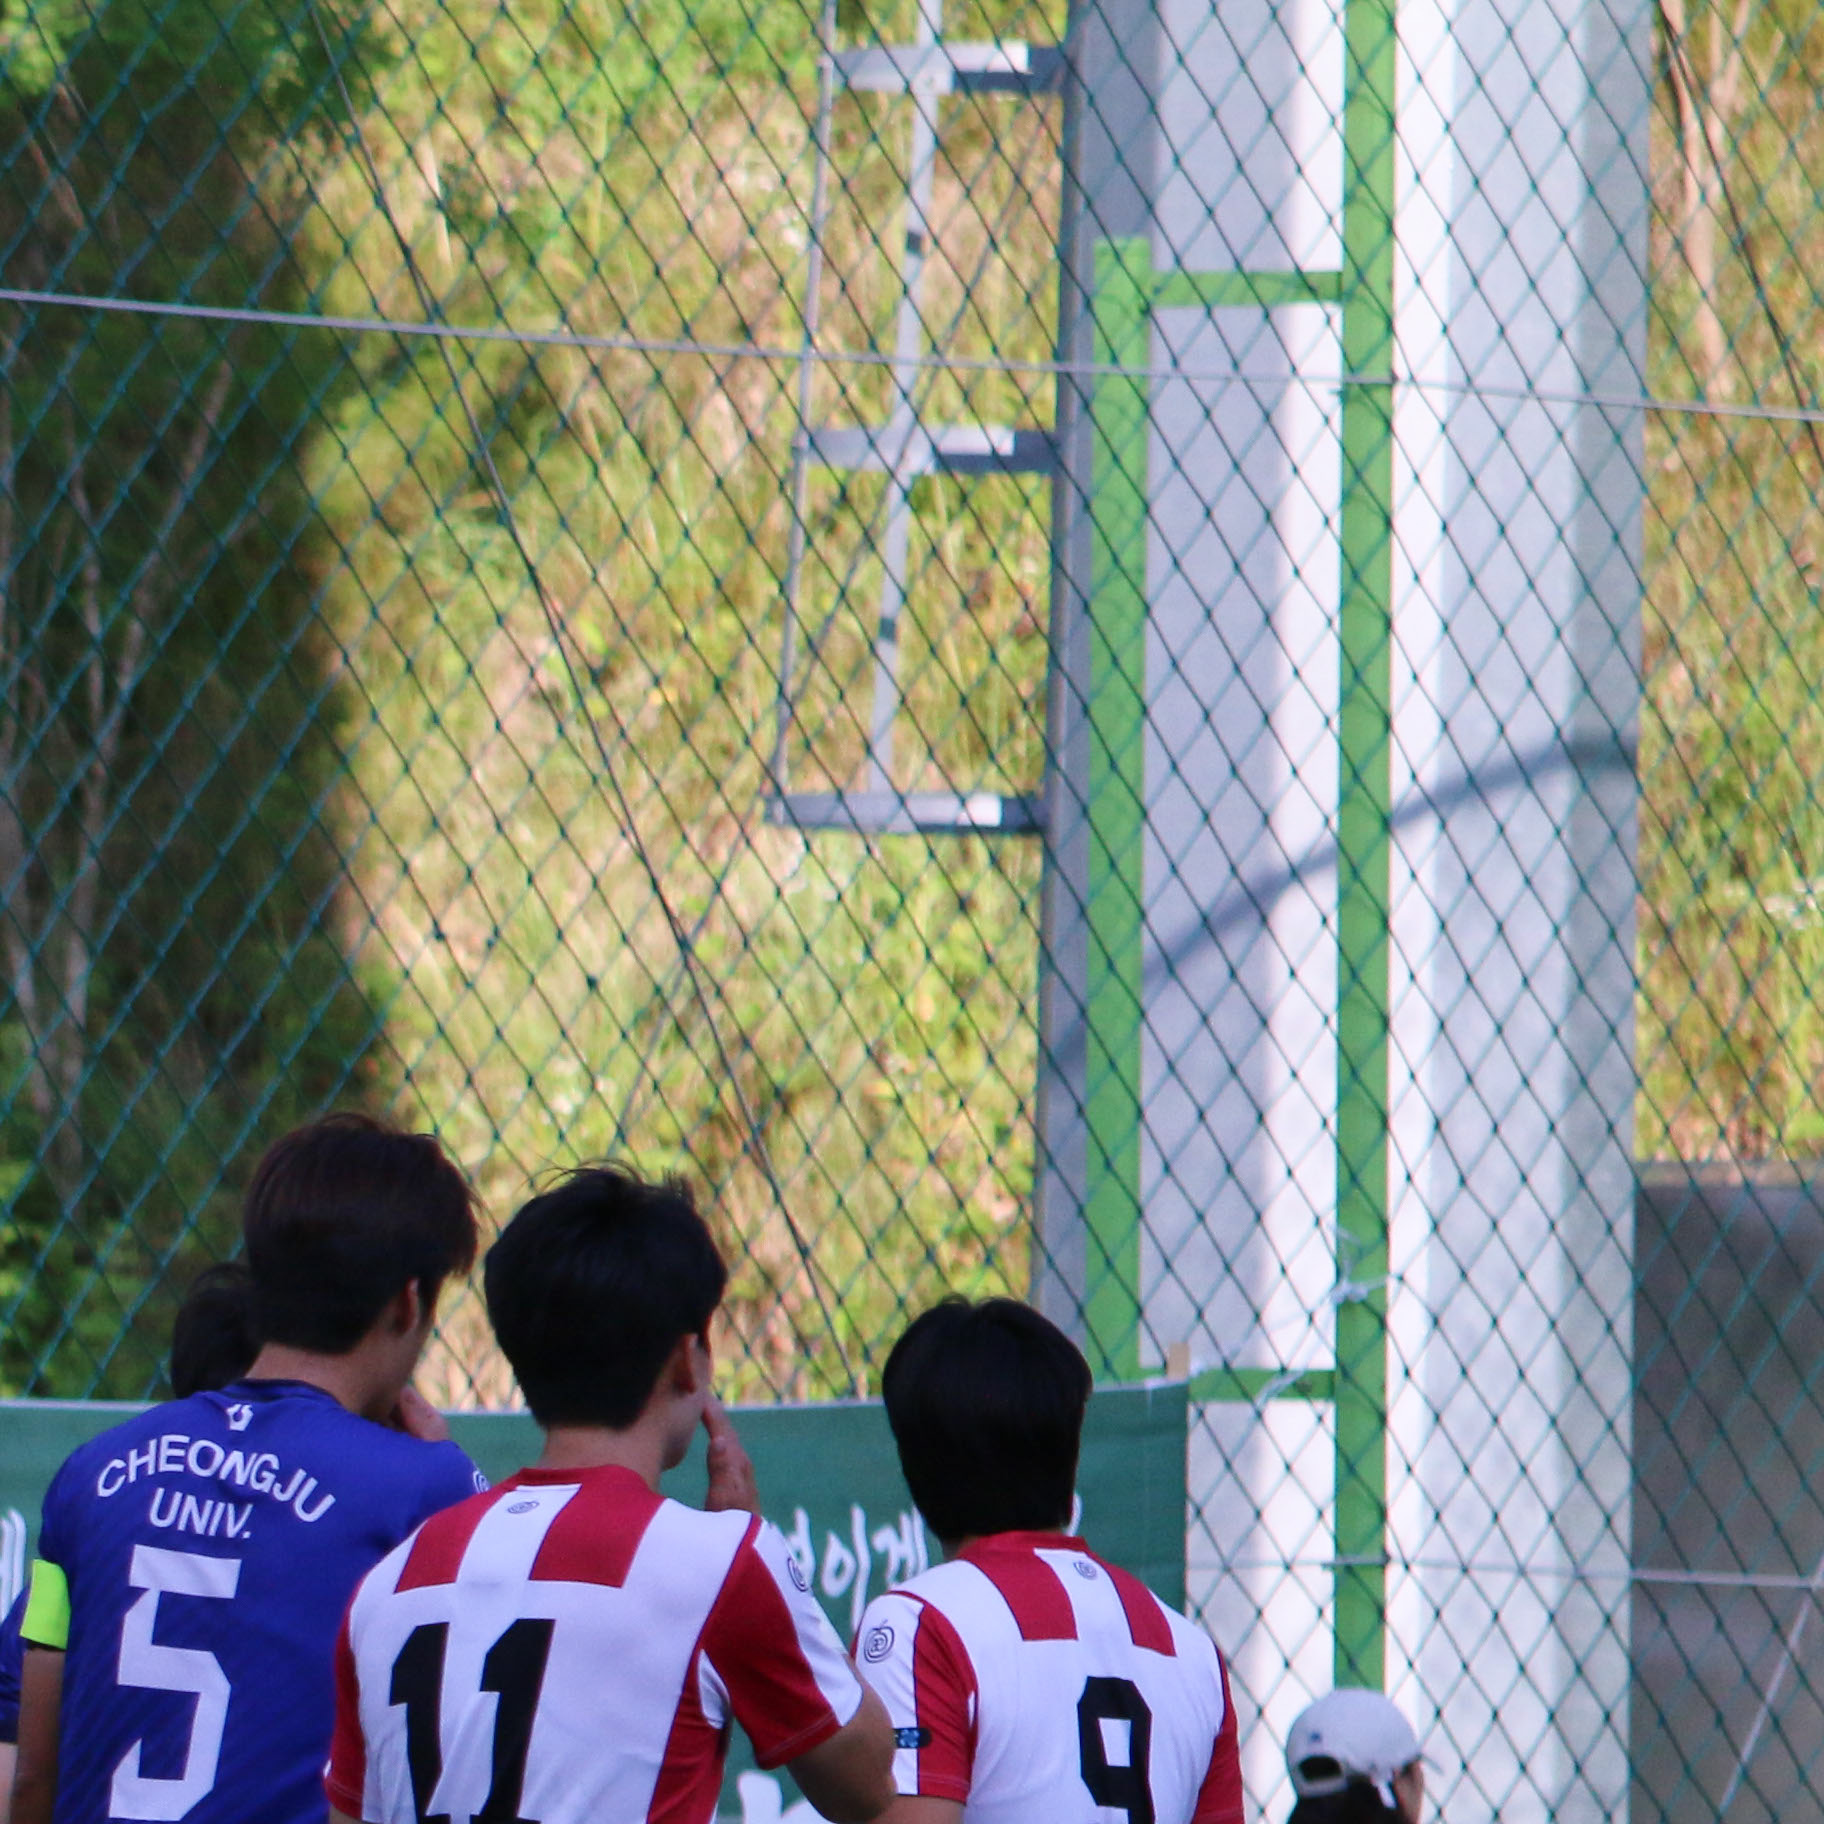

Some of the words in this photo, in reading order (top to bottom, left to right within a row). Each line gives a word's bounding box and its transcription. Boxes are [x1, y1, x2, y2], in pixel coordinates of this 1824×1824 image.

[97, 1434, 336, 1523] CHEONGJU
[149, 1487, 253, 1539] UNIV.
[108, 1543, 242, 1822] 5
